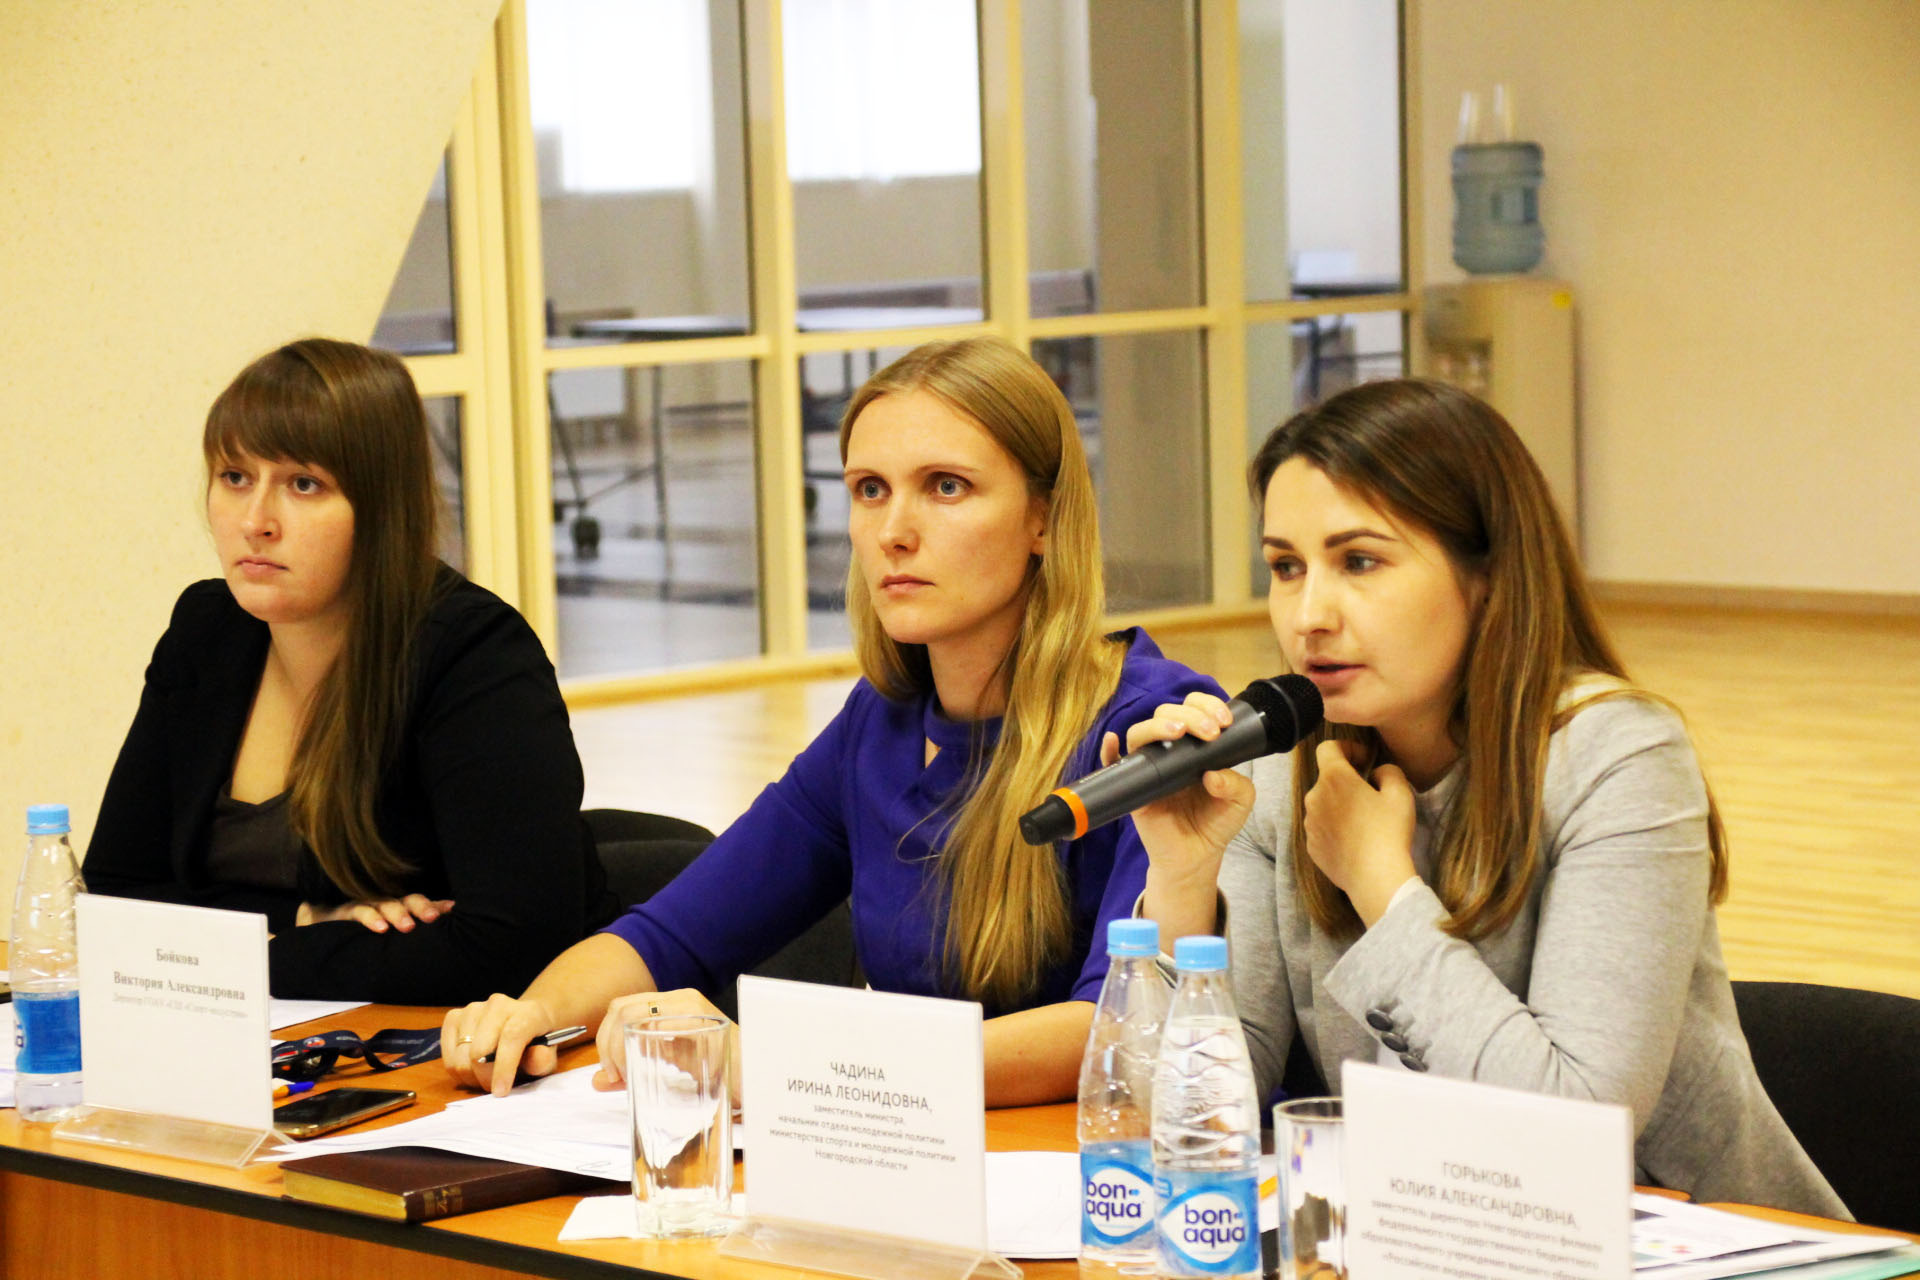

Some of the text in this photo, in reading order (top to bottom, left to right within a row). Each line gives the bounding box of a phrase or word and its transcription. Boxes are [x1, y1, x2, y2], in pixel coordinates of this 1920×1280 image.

[155, 947, 199, 966] Бойкова
[113, 970, 246, 1001] Виктория Александровна
[830, 1061, 886, 1081] ЧАДИНА
[787, 1078, 933, 1114] ИРИНА ЛЕОНИДОВНА,
[813, 1104, 863, 1120] заместитель
[778, 1114, 945, 1146] начальник отдела молодежной политики
[769, 1128, 824, 1144] министерства
[825, 1136, 852, 1148] спорта
[861, 1142, 914, 1157] молодежной
[915, 1149, 957, 1163] политики
[815, 1149, 909, 1171] Новгородской области
[1442, 1161, 1522, 1190] ГОРЬКОВА
[1390, 1177, 1436, 1200] ЮЛИЯ
[1086, 1199, 1142, 1222] aqua
[1183, 1226, 1246, 1249] aqua
